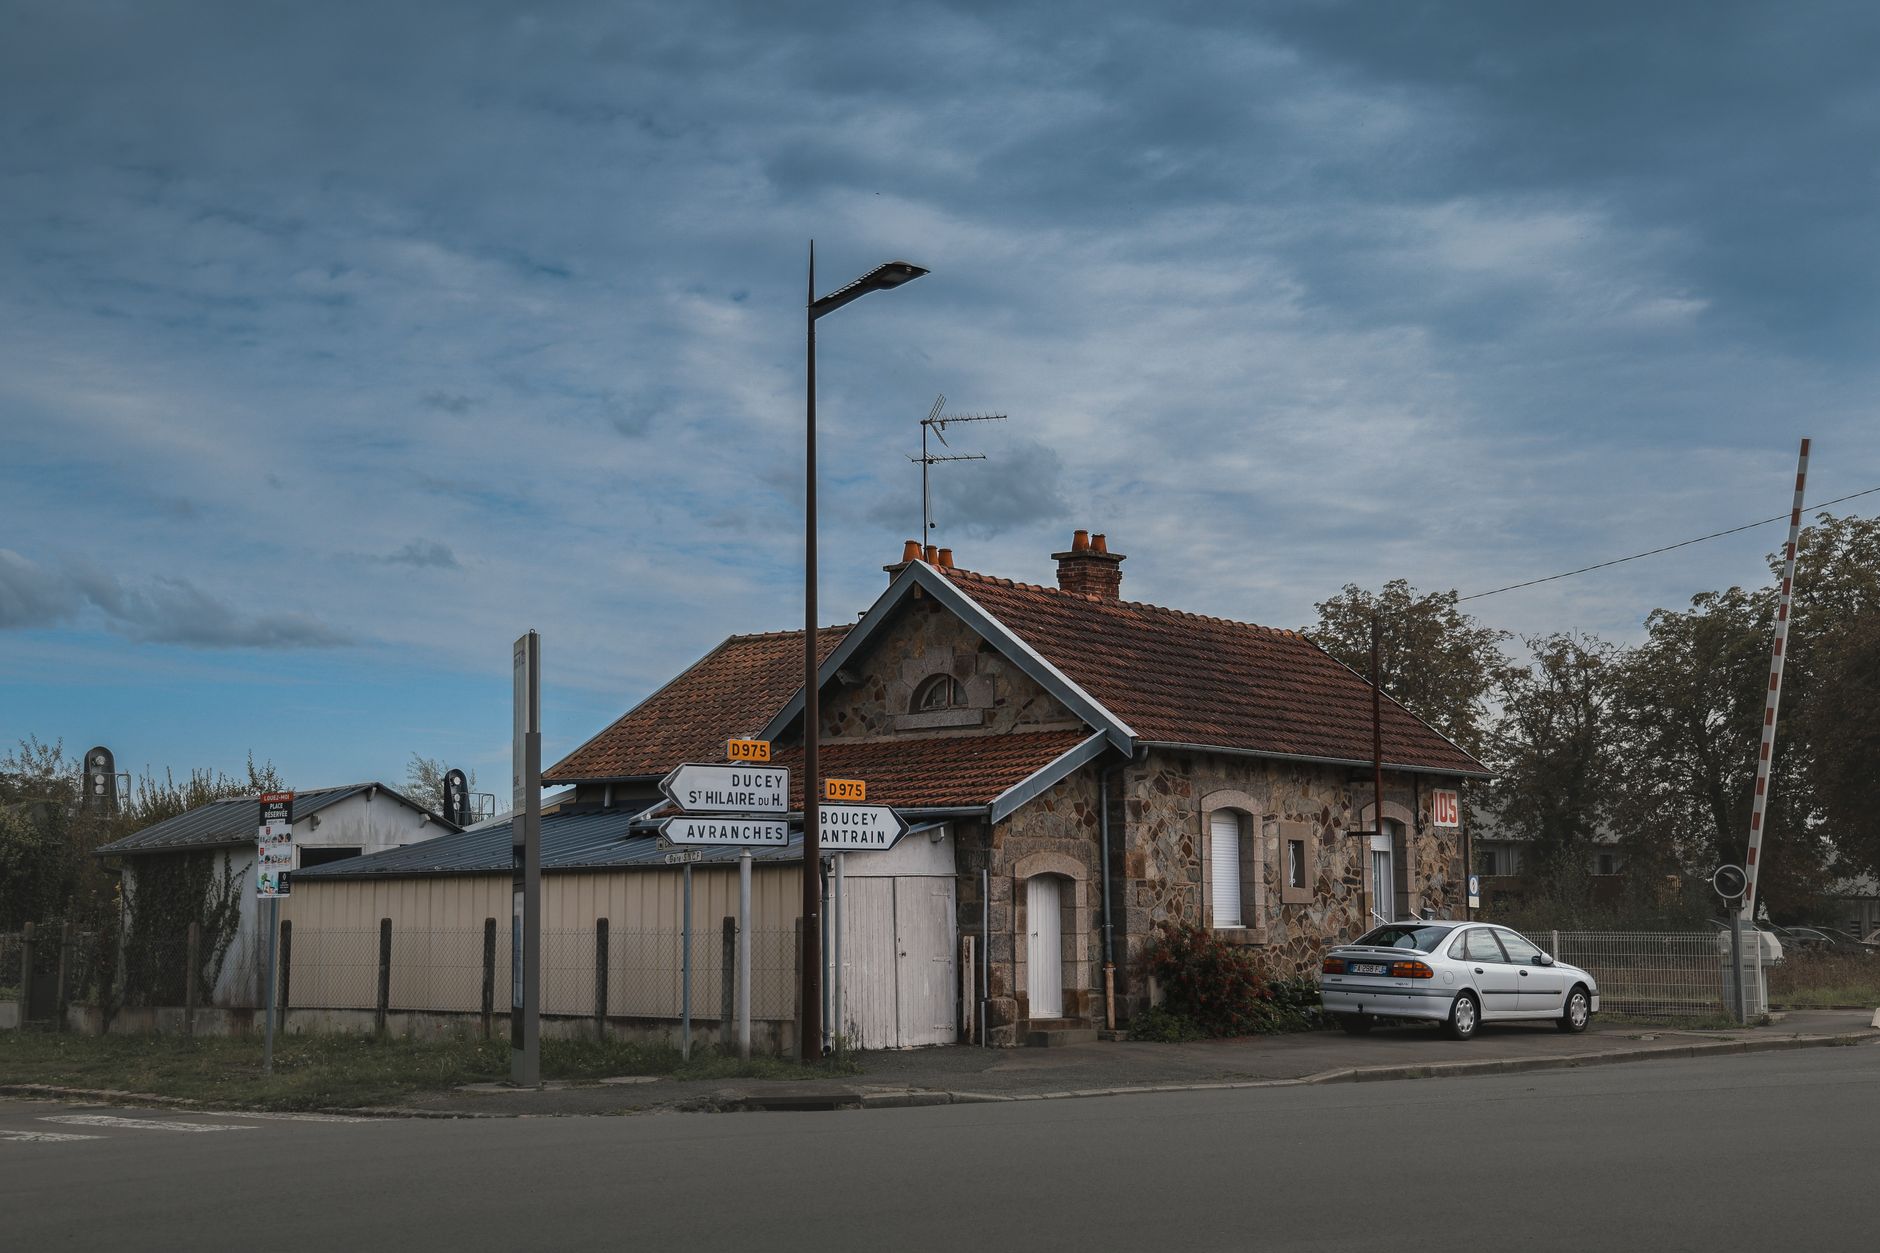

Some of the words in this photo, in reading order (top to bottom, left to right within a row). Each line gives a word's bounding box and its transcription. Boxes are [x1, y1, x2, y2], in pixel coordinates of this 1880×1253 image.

[732, 743, 767, 758] D975
[732, 774, 783, 788] DUCEY
[829, 783, 863, 797] D975
[263, 794, 290, 802] LOUEZ-MOI
[705, 791, 756, 806] HILAIRE
[758, 797, 769, 806] DU
[772, 793, 783, 806] H.
[269, 802, 283, 810] PLACE
[1434, 791, 1457, 823] 105
[264, 809, 288, 818] RÉSERVÉE
[820, 812, 878, 826] BOUCEY
[687, 825, 783, 840] AVRANCHES
[821, 830, 885, 844] ANTRAIN
